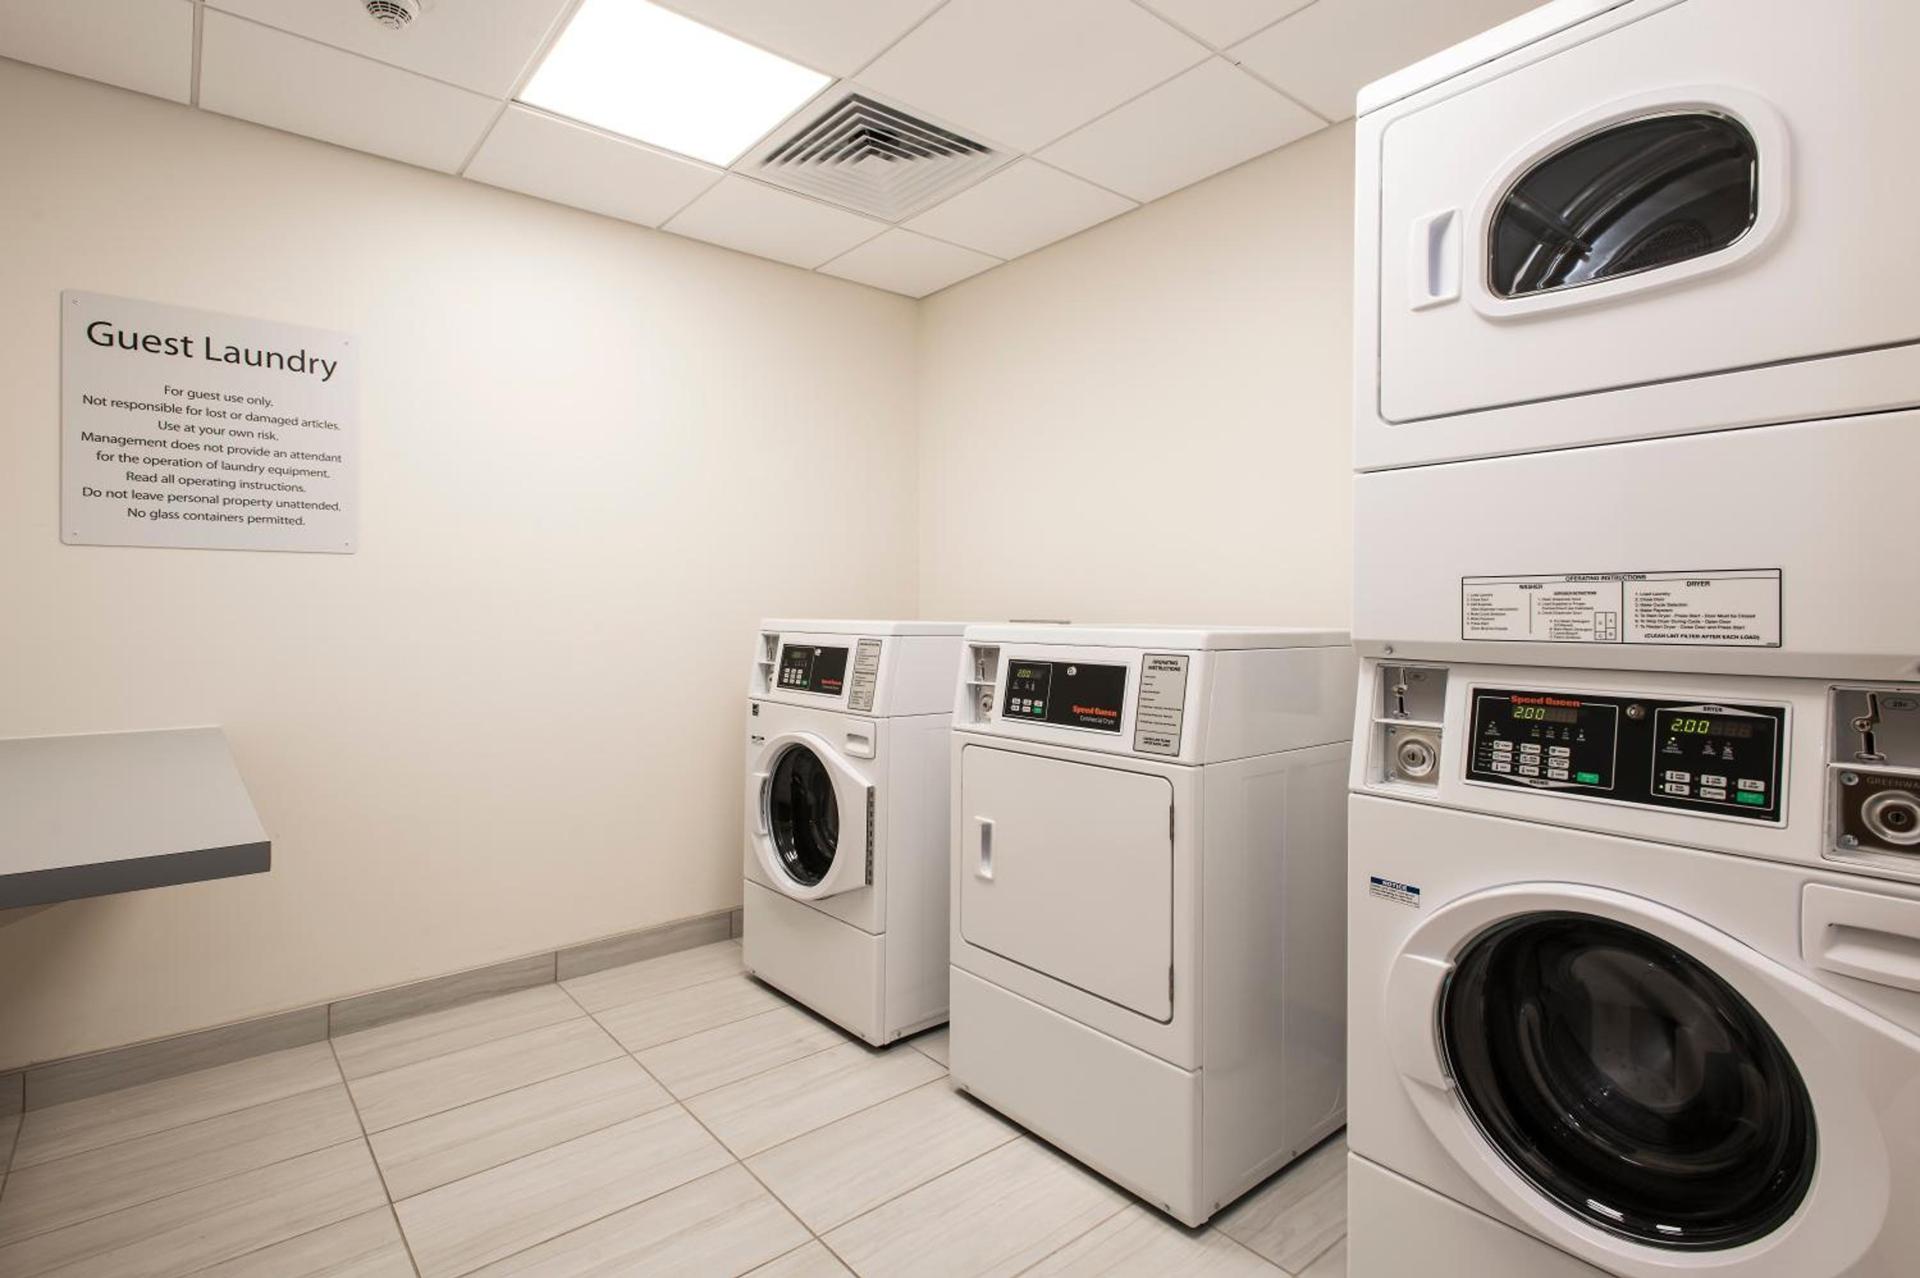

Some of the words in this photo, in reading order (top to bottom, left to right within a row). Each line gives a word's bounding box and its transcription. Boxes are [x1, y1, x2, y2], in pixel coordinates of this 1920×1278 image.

[87, 321, 194, 358] Guest
[205, 336, 337, 382] Laundry
[164, 385, 184, 397] For
[187, 389, 220, 401] guest
[223, 394, 244, 404] use
[246, 396, 274, 407] only.
[82, 394, 108, 407] Not
[111, 400, 183, 415] responsible
[186, 405, 203, 416] for
[206, 408, 227, 419] lost
[230, 412, 242, 420] or
[245, 412, 299, 428] damaged
[300, 418, 341, 431] articles.
[158, 420, 181, 432] Use
[184, 424, 195, 433] at
[199, 427, 226, 437] your
[229, 429, 255, 438] own
[257, 430, 279, 441] risk.
[81, 431, 168, 449] Management
[171, 439, 200, 451] does
[203, 443, 224, 453] not
[227, 445, 271, 457] provide
[273, 449, 288, 458] an
[290, 451, 342, 463] attendant
[96, 450, 116, 462] for
[118, 453, 140, 464] the
[143, 456, 203, 469] operation
[206, 460, 219, 469] of
[221, 461, 265, 475] laundry
[268, 465, 331, 479] equipment.
[126, 471, 158, 483] Read
[161, 474, 175, 484] all
[178, 477, 237, 490] operating
[240, 480, 306, 493] instructions.
[82, 486, 102, 498] Do
[105, 489, 128, 499] not
[131, 490, 164, 502] leave
[167, 493, 220, 504] personal
[222, 496, 274, 510] property
[276, 500, 342, 512] unattended.
[127, 507, 146, 518] No
[149, 508, 180, 521] glass
[183, 511, 244, 524] containers
[247, 515, 306, 526] permitted.
[1686, 580, 1710, 588] DRYER
[1072, 705, 1095, 715] Speed
[1096, 706, 1117, 717] Queen
[1511, 695, 1544, 705] Speed
[1545, 697, 1580, 708] Queen
[1514, 706, 1546, 720] 2.00
[1671, 718, 1710, 734] 2.00
